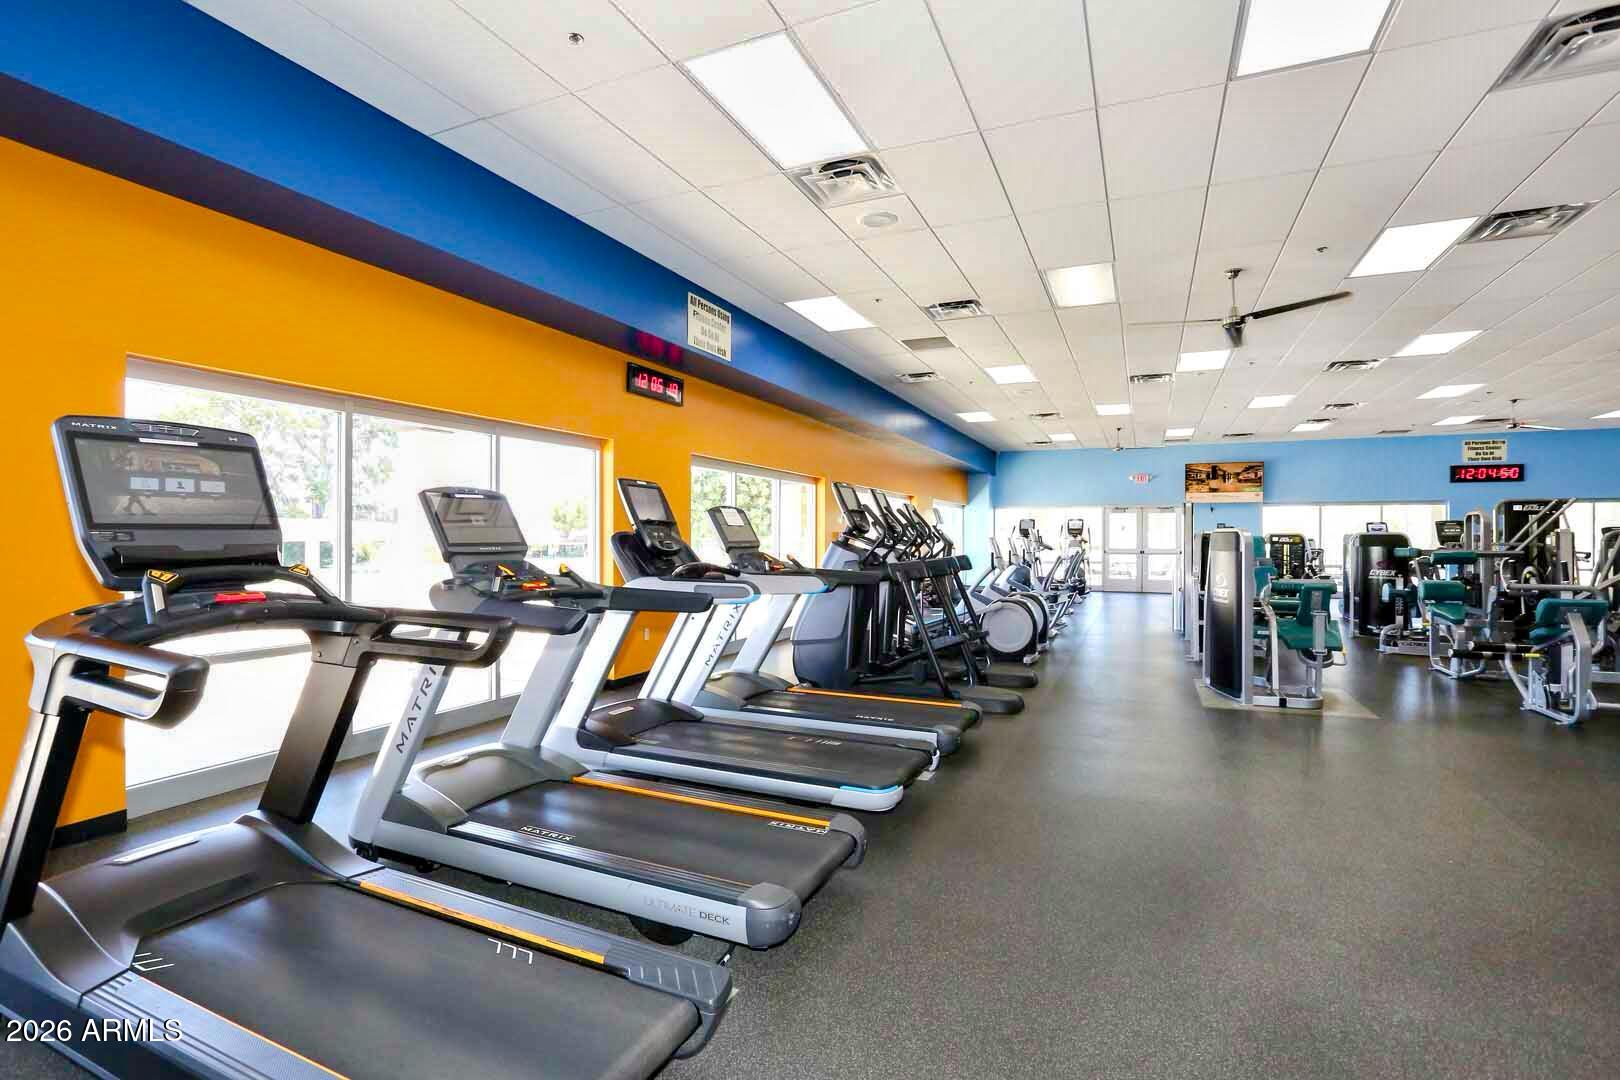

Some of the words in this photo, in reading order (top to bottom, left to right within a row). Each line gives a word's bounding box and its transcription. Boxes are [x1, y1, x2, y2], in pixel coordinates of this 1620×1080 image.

[697, 299, 717, 317] Persons
[71, 421, 117, 430] MATRIX
[1369, 569, 1397, 577] CYBEX
[704, 603, 742, 666] MATRIX
[395, 666, 436, 754] MATRI
[520, 825, 574, 841] MATRIX
[699, 911, 731, 926] DECK
